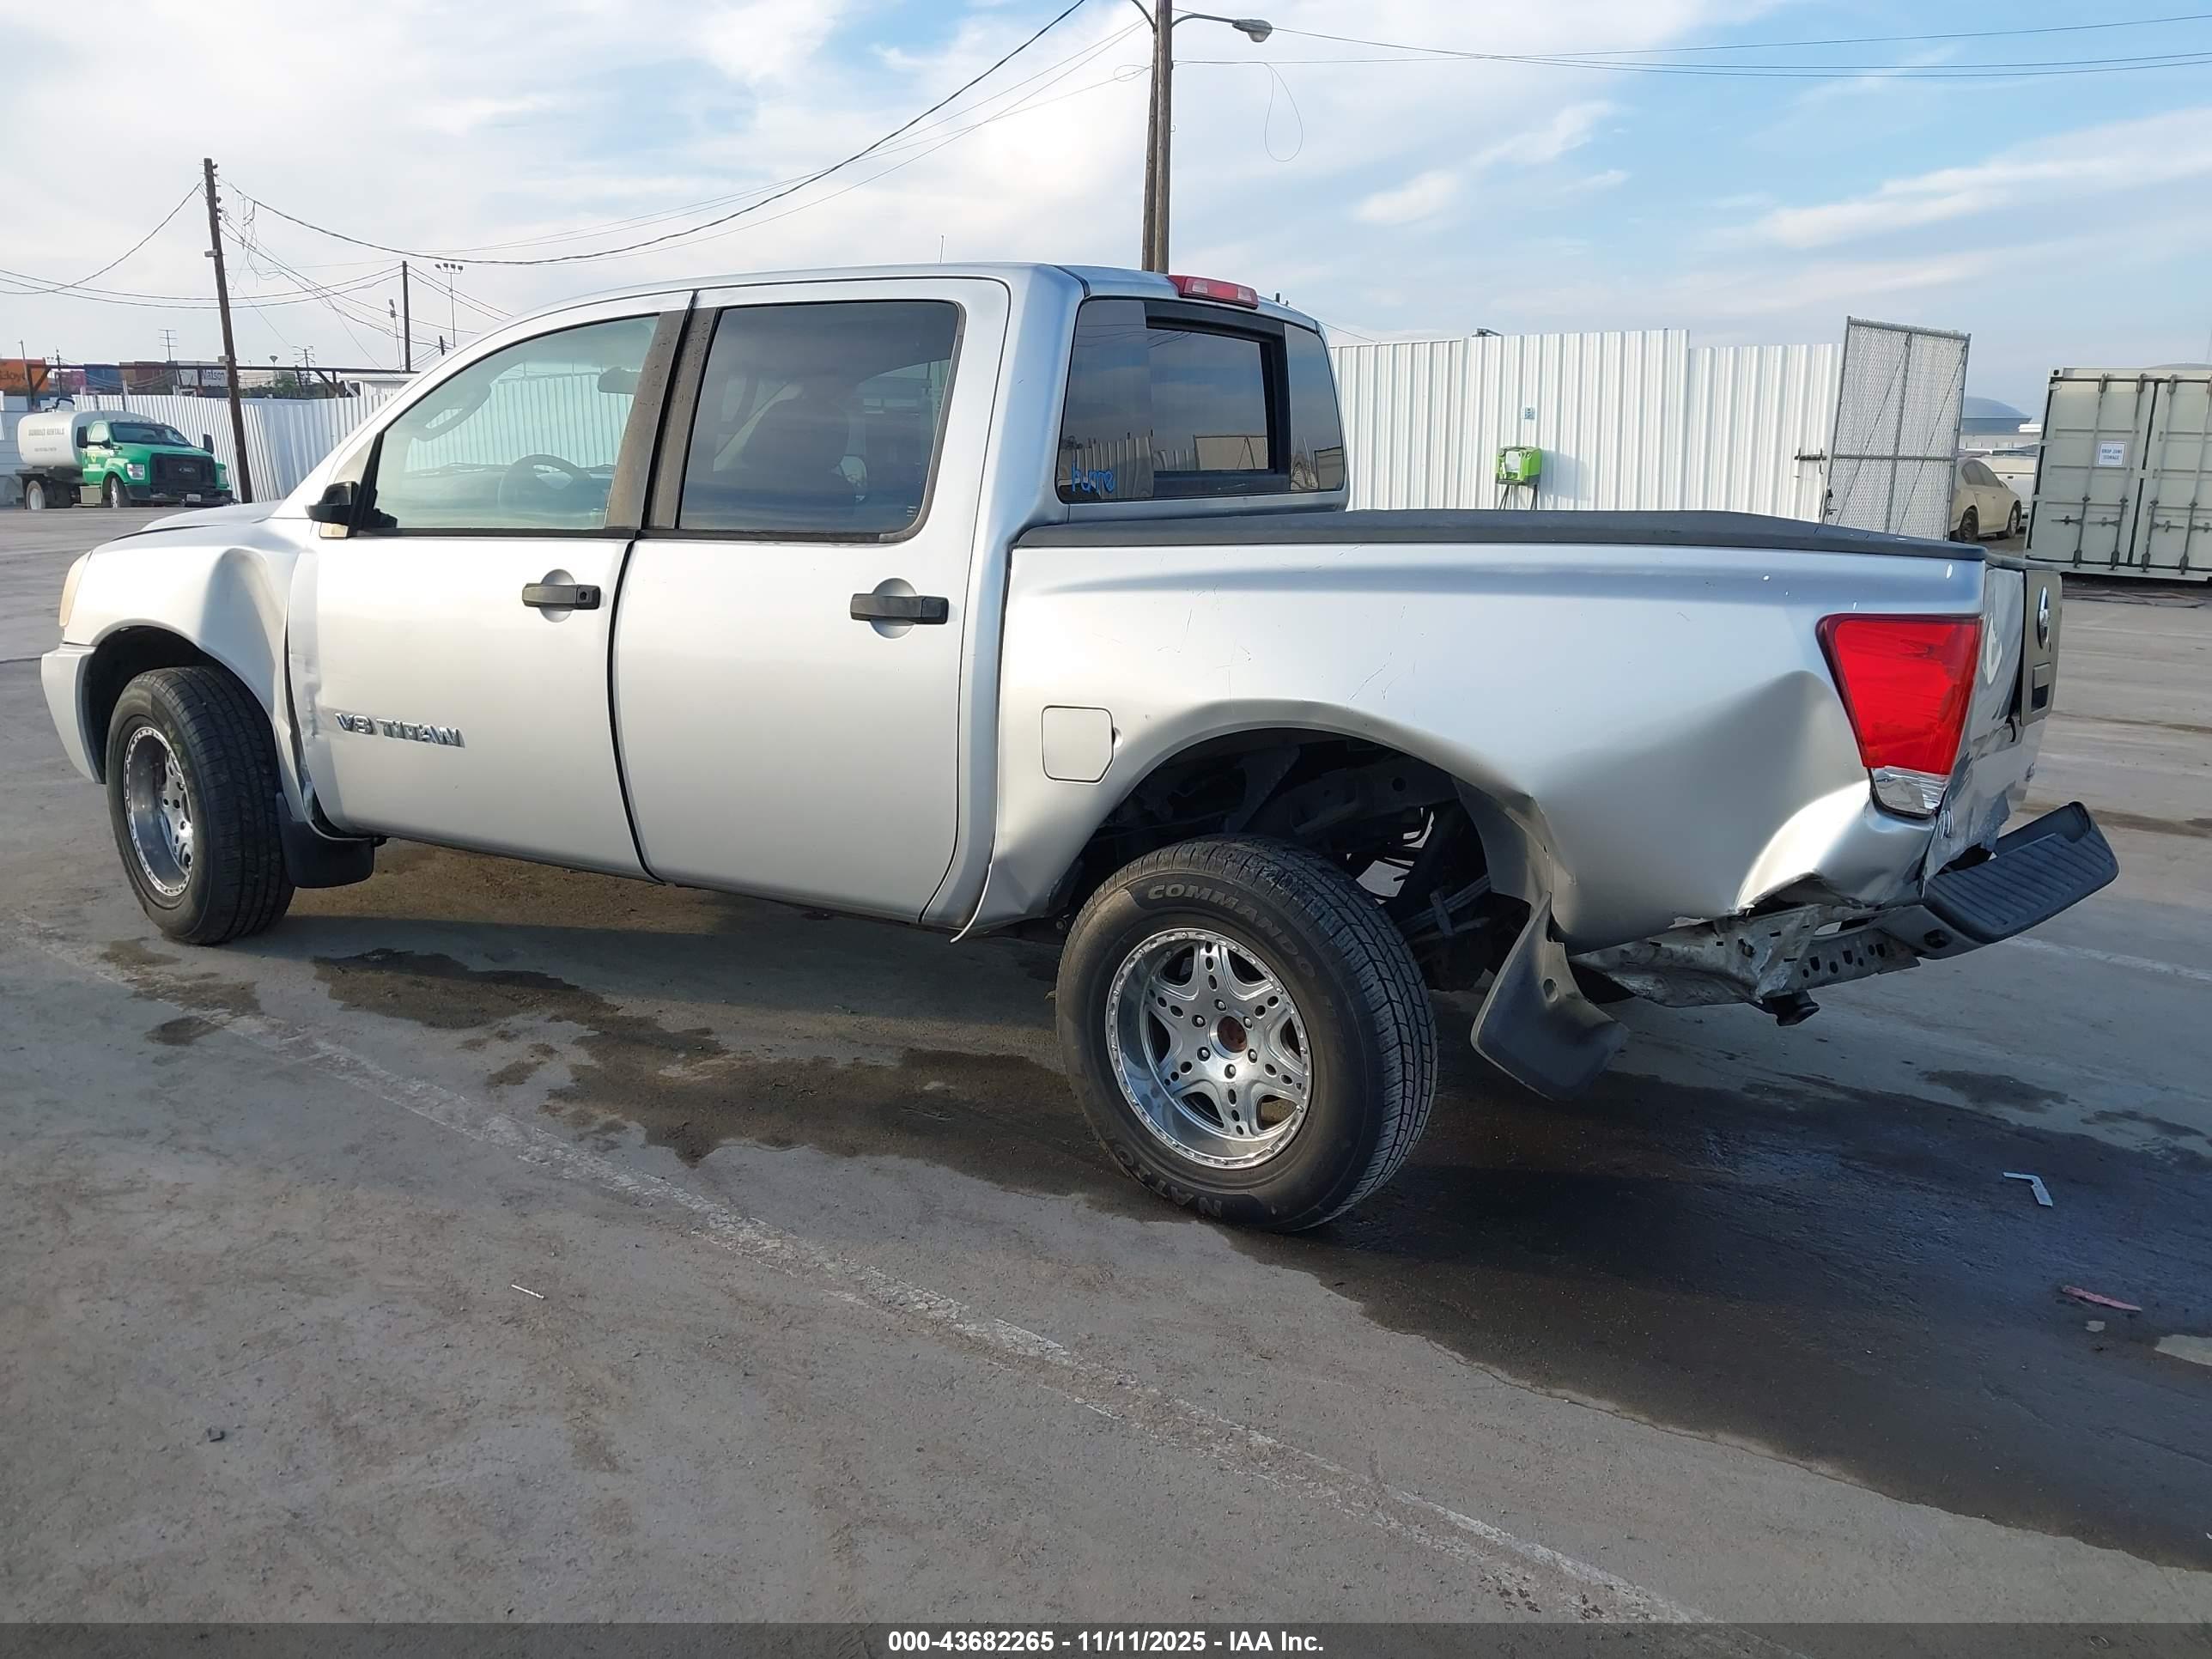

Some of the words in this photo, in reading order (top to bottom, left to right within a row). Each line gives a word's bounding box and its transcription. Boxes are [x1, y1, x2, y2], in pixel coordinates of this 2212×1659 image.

[335, 713, 377, 736] V8
[376, 718, 465, 748] TITAN
[1147, 884, 1316, 977] COMMANDO
